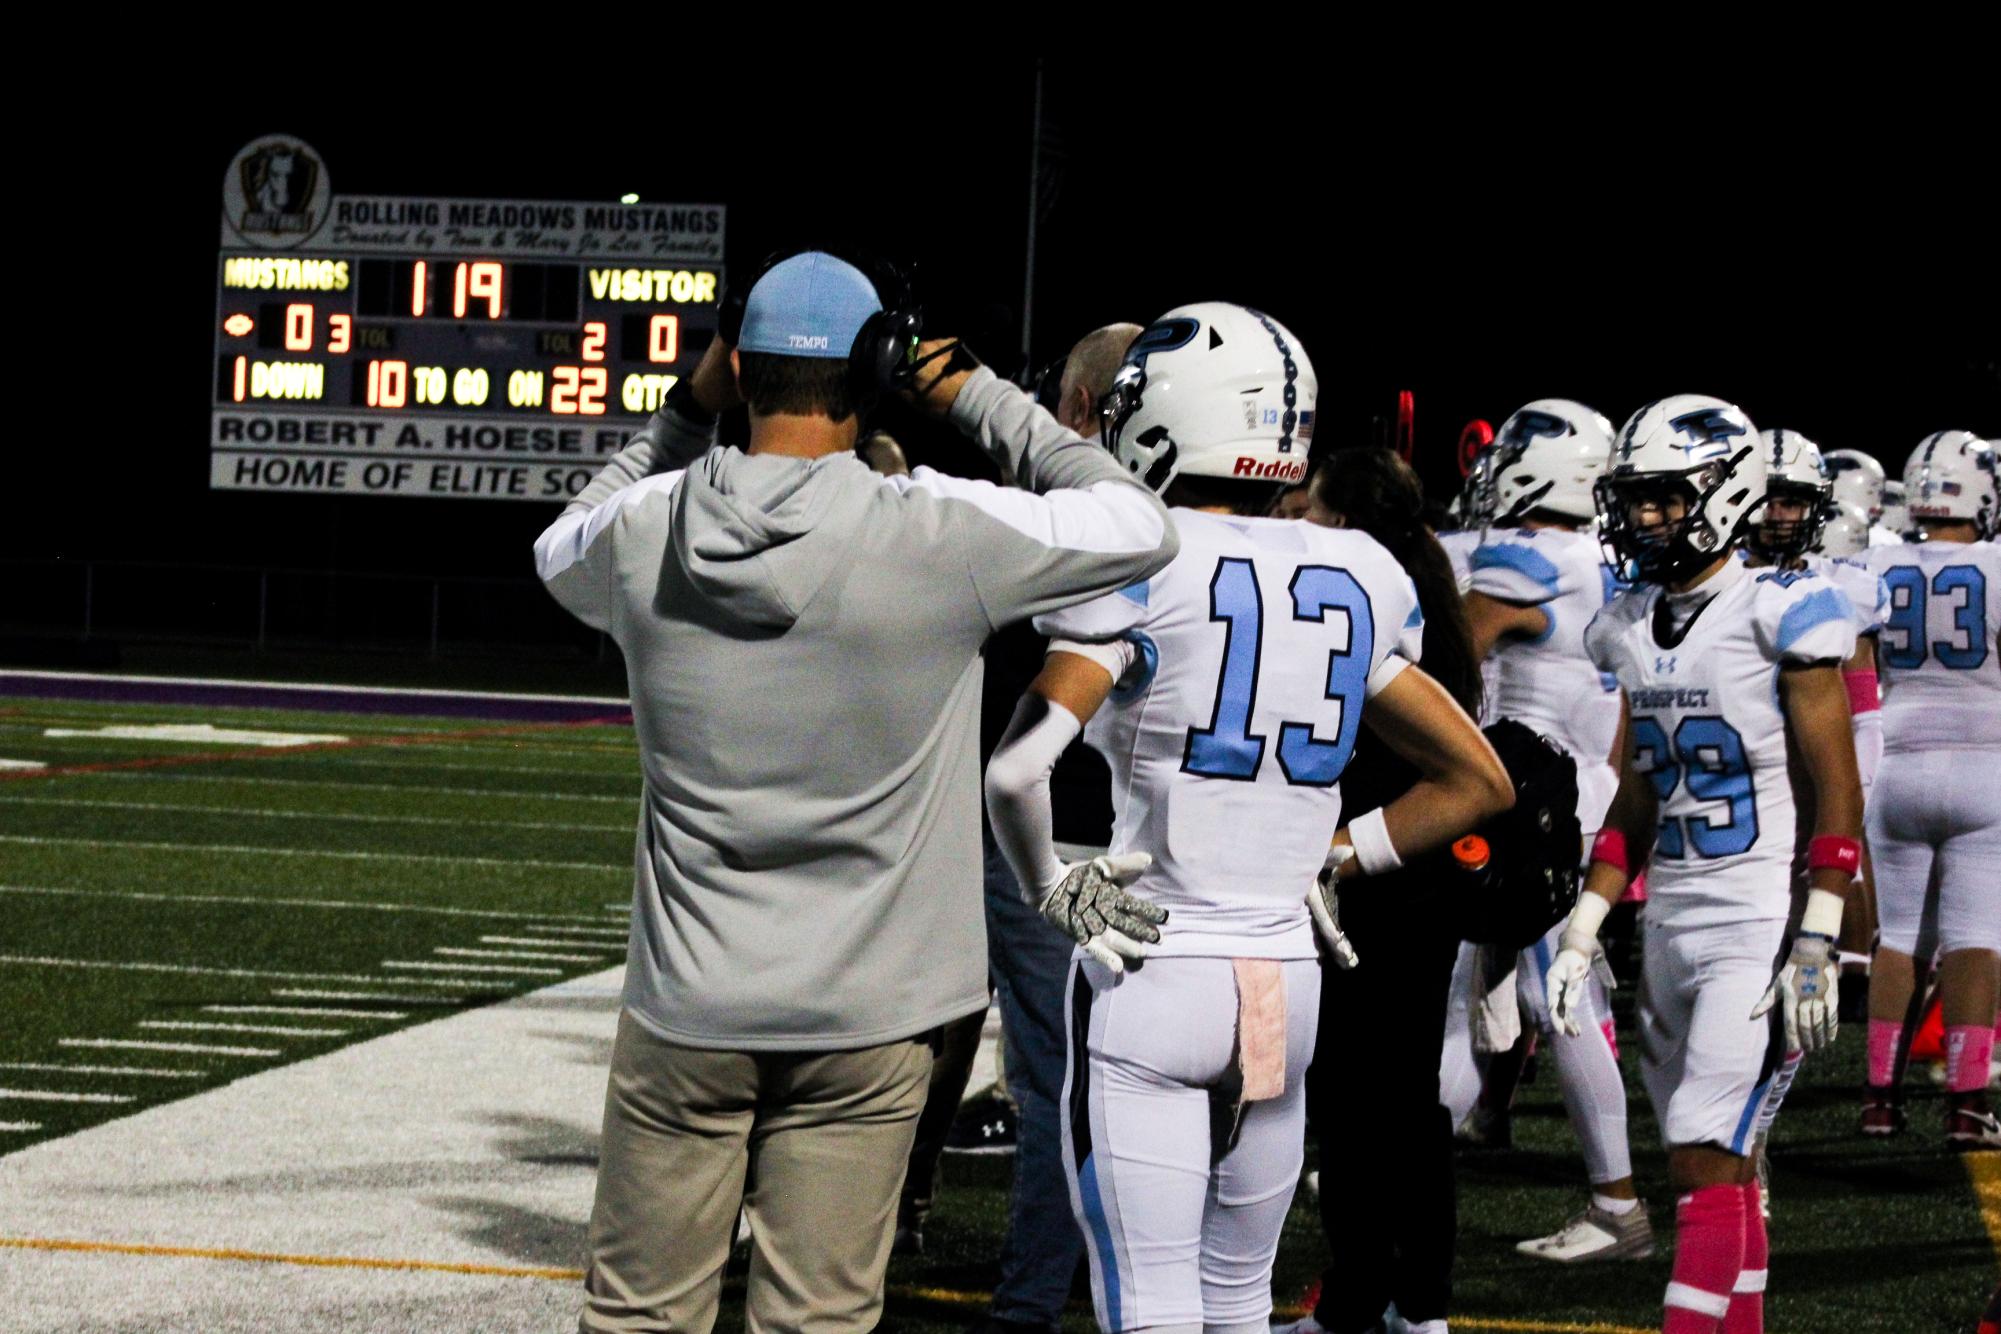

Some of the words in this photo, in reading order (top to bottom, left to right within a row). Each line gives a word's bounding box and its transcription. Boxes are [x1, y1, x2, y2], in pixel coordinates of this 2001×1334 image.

[338, 201, 440, 227] ROLLING
[450, 203, 576, 230] MEADOWS
[584, 207, 720, 234] MUSTANGS
[415, 228, 437, 248] by
[651, 234, 720, 256] Family
[224, 257, 350, 291] MUSTANGS
[588, 268, 717, 303] VISITOR
[285, 303, 314, 352] 0
[327, 313, 352, 355] 3
[581, 321, 607, 362] 2
[649, 314, 679, 364] 0
[788, 335, 828, 349] TEMPO
[233, 354, 247, 403] 1
[251, 360, 325, 400] DOWN
[367, 359, 407, 408] 10
[413, 365, 448, 405] TO
[452, 367, 490, 407] GO
[507, 368, 545, 408] ON
[550, 366, 608, 415] 22
[219, 417, 385, 447] ROBERT
[396, 423, 433, 449] A.
[445, 424, 583, 454] HOESE
[1262, 409, 1278, 425] 13
[235, 457, 349, 488] HOME
[362, 462, 414, 491] OF
[429, 464, 529, 495] ELITE
[1232, 456, 1308, 481] Riddell
[1883, 564, 1989, 670] 93
[1180, 556, 1376, 786] 13
[1631, 688, 1709, 709] PROSPECT
[1630, 714, 1761, 860] 29
